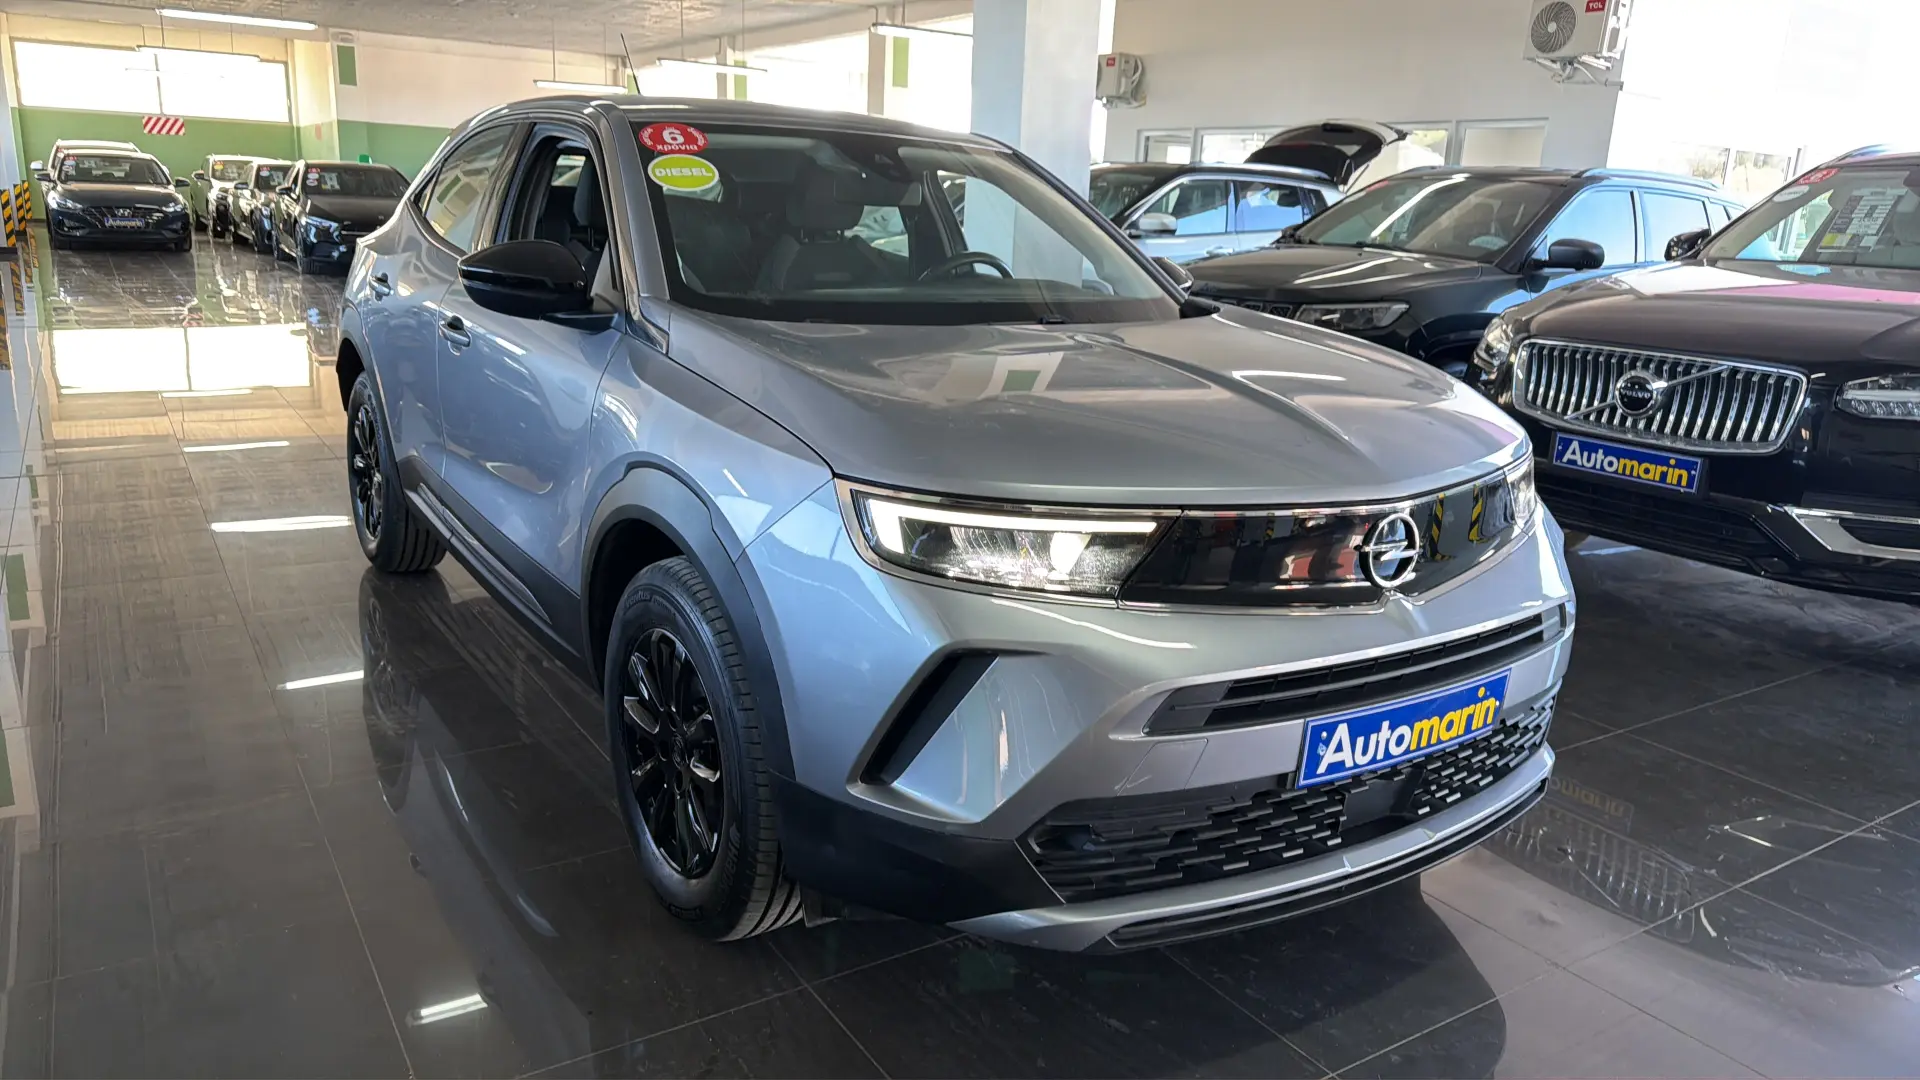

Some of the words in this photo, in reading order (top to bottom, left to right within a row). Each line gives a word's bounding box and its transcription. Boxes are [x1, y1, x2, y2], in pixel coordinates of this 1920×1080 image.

[662, 128, 685, 145] 6
[656, 143, 699, 152] χρόνια
[654, 168, 712, 177] DIESEL
[1620, 388, 1651, 399] VOLVO
[1562, 440, 1688, 487] Automarin
[1316, 686, 1497, 774] Automarin
